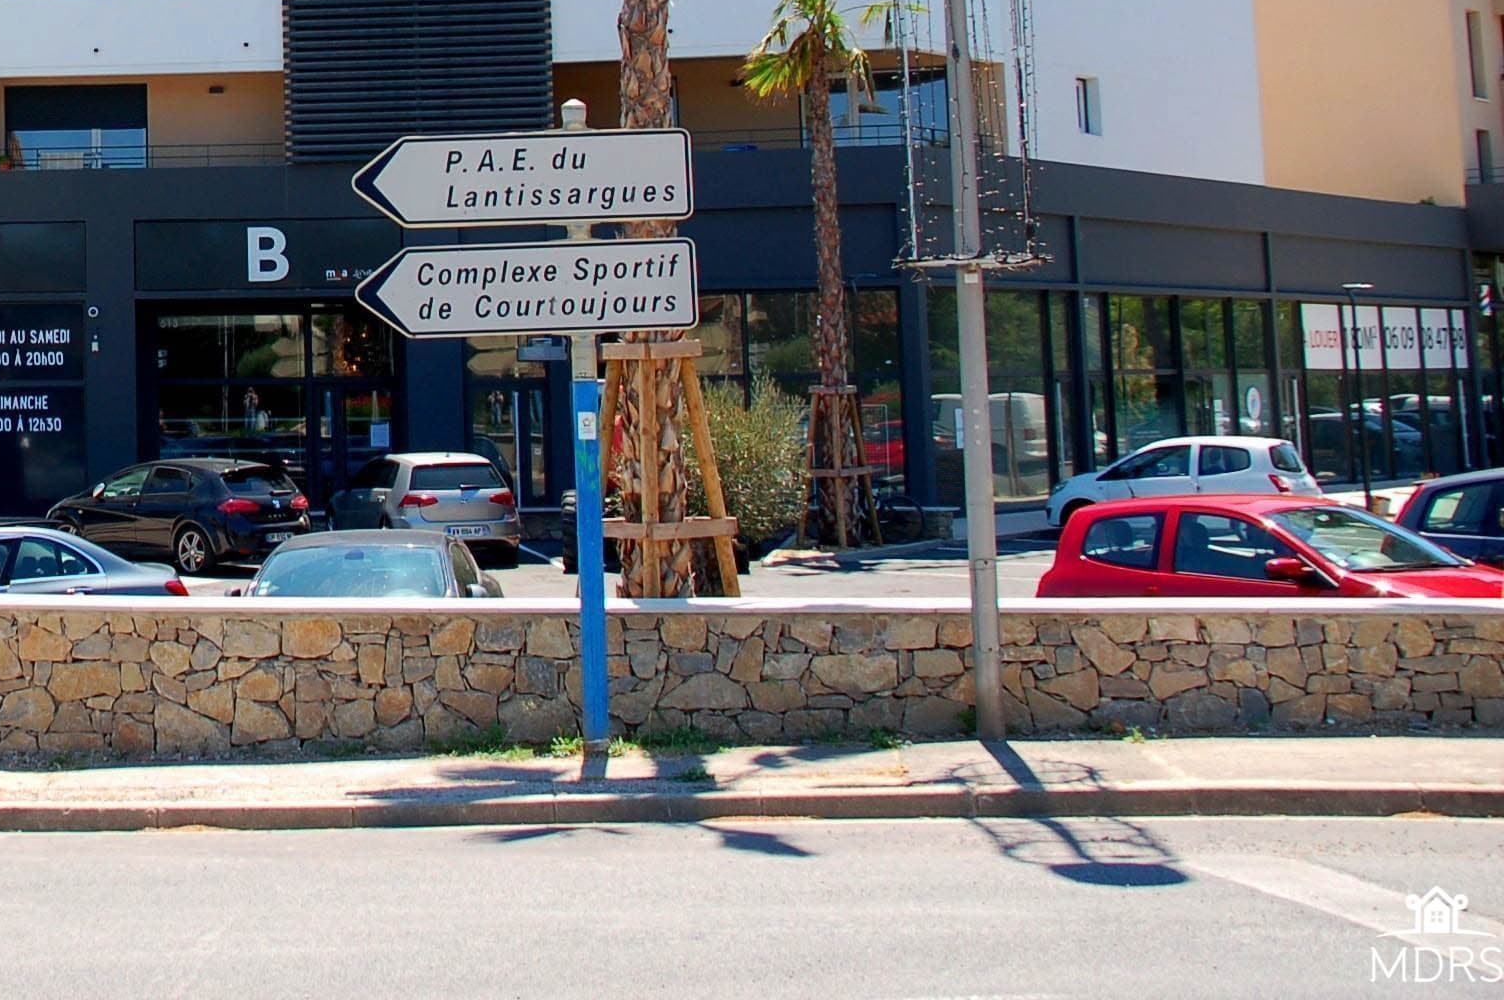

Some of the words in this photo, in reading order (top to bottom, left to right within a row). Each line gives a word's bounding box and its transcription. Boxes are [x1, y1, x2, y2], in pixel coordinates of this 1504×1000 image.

[445, 148, 535, 173] P.A.E.
[552, 147, 586, 170] du
[446, 183, 676, 210] Lantissargues
[247, 226, 289, 282] B
[417, 260, 558, 290] Complexe
[573, 253, 680, 286] Sportif
[418, 296, 452, 320] de
[475, 290, 677, 321] Courtoujours
[9, 329, 26, 344] AU
[29, 328, 71, 344] SAMEDI
[14, 348, 22, 367] À
[25, 351, 64, 366] 20h00
[16, 413, 24, 432] À
[28, 417, 62, 432] 12h30
